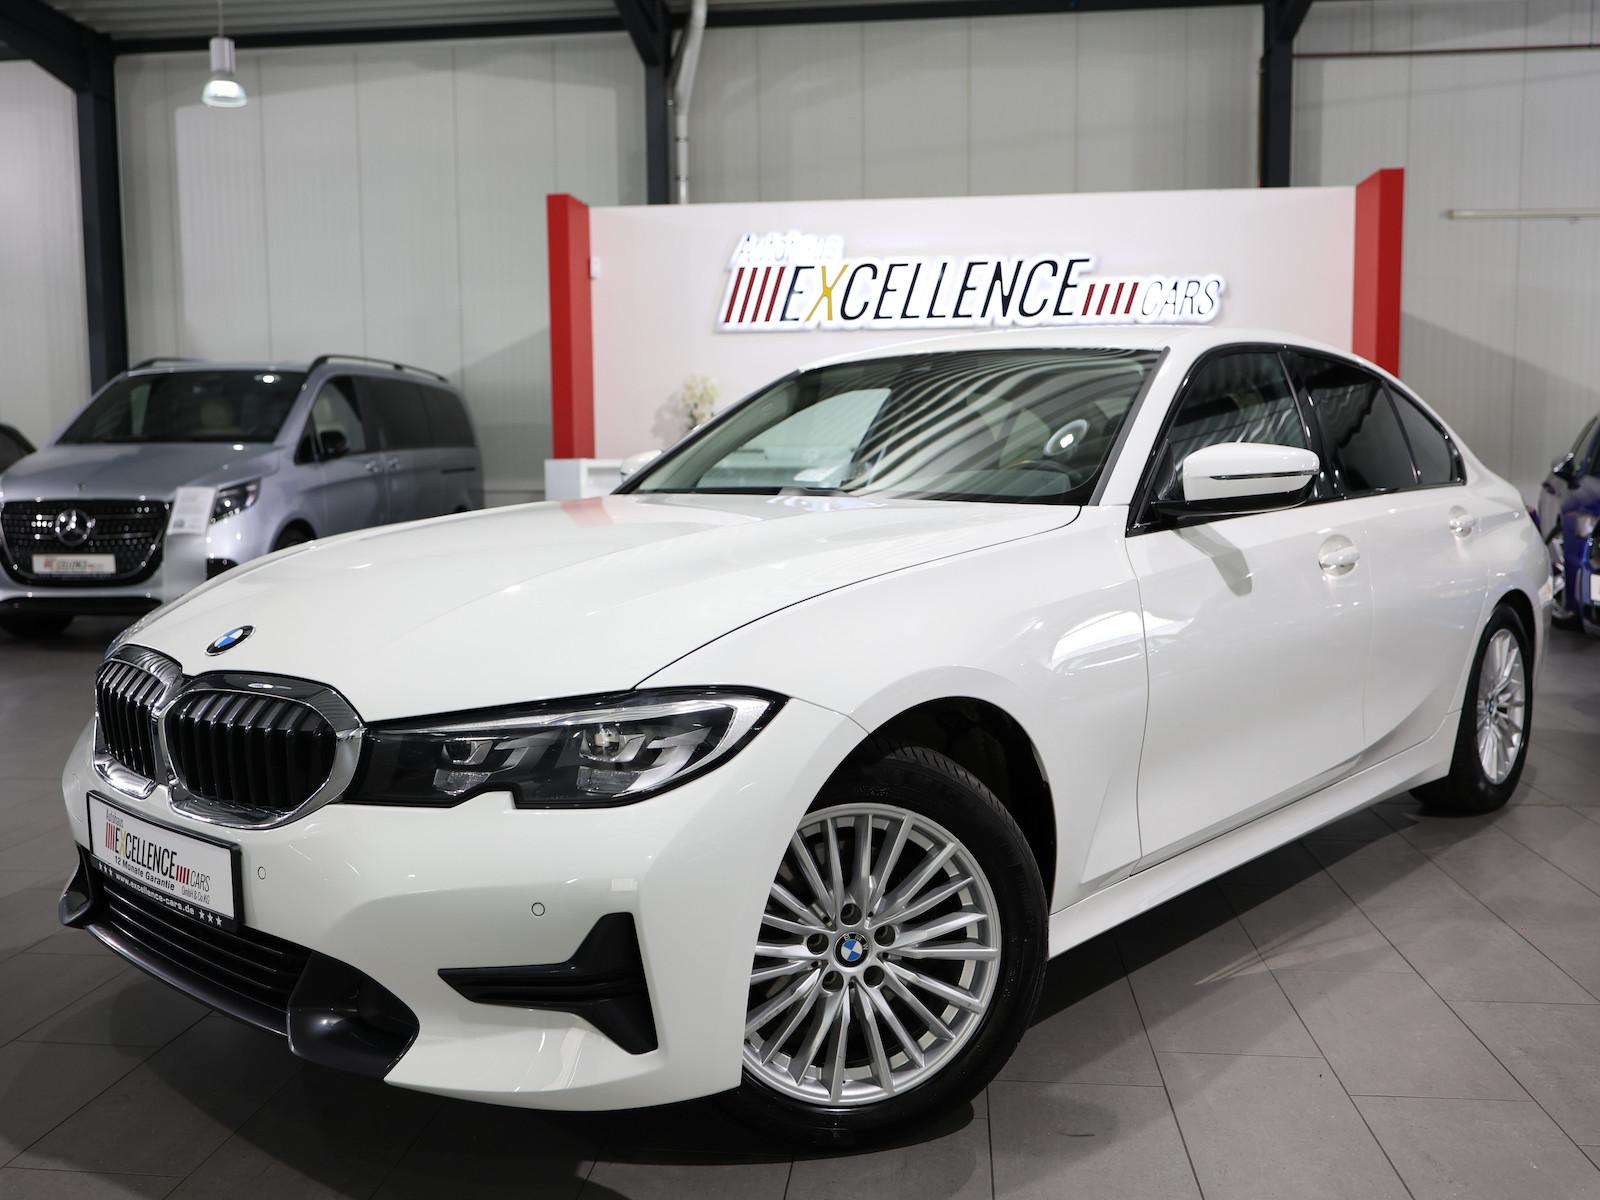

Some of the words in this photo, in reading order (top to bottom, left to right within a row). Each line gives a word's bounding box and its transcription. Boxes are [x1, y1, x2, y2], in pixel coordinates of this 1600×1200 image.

[780, 258, 1091, 322] EXCELLENCE
[1141, 279, 1222, 317] CARS
[115, 827, 178, 880] EXCELLENCE
[190, 870, 211, 892] CARS
[115, 855, 122, 866] 12
[122, 859, 144, 878] Monate
[145, 871, 175, 891] Garantie
[115, 872, 195, 915] www.excellence-cars.de
